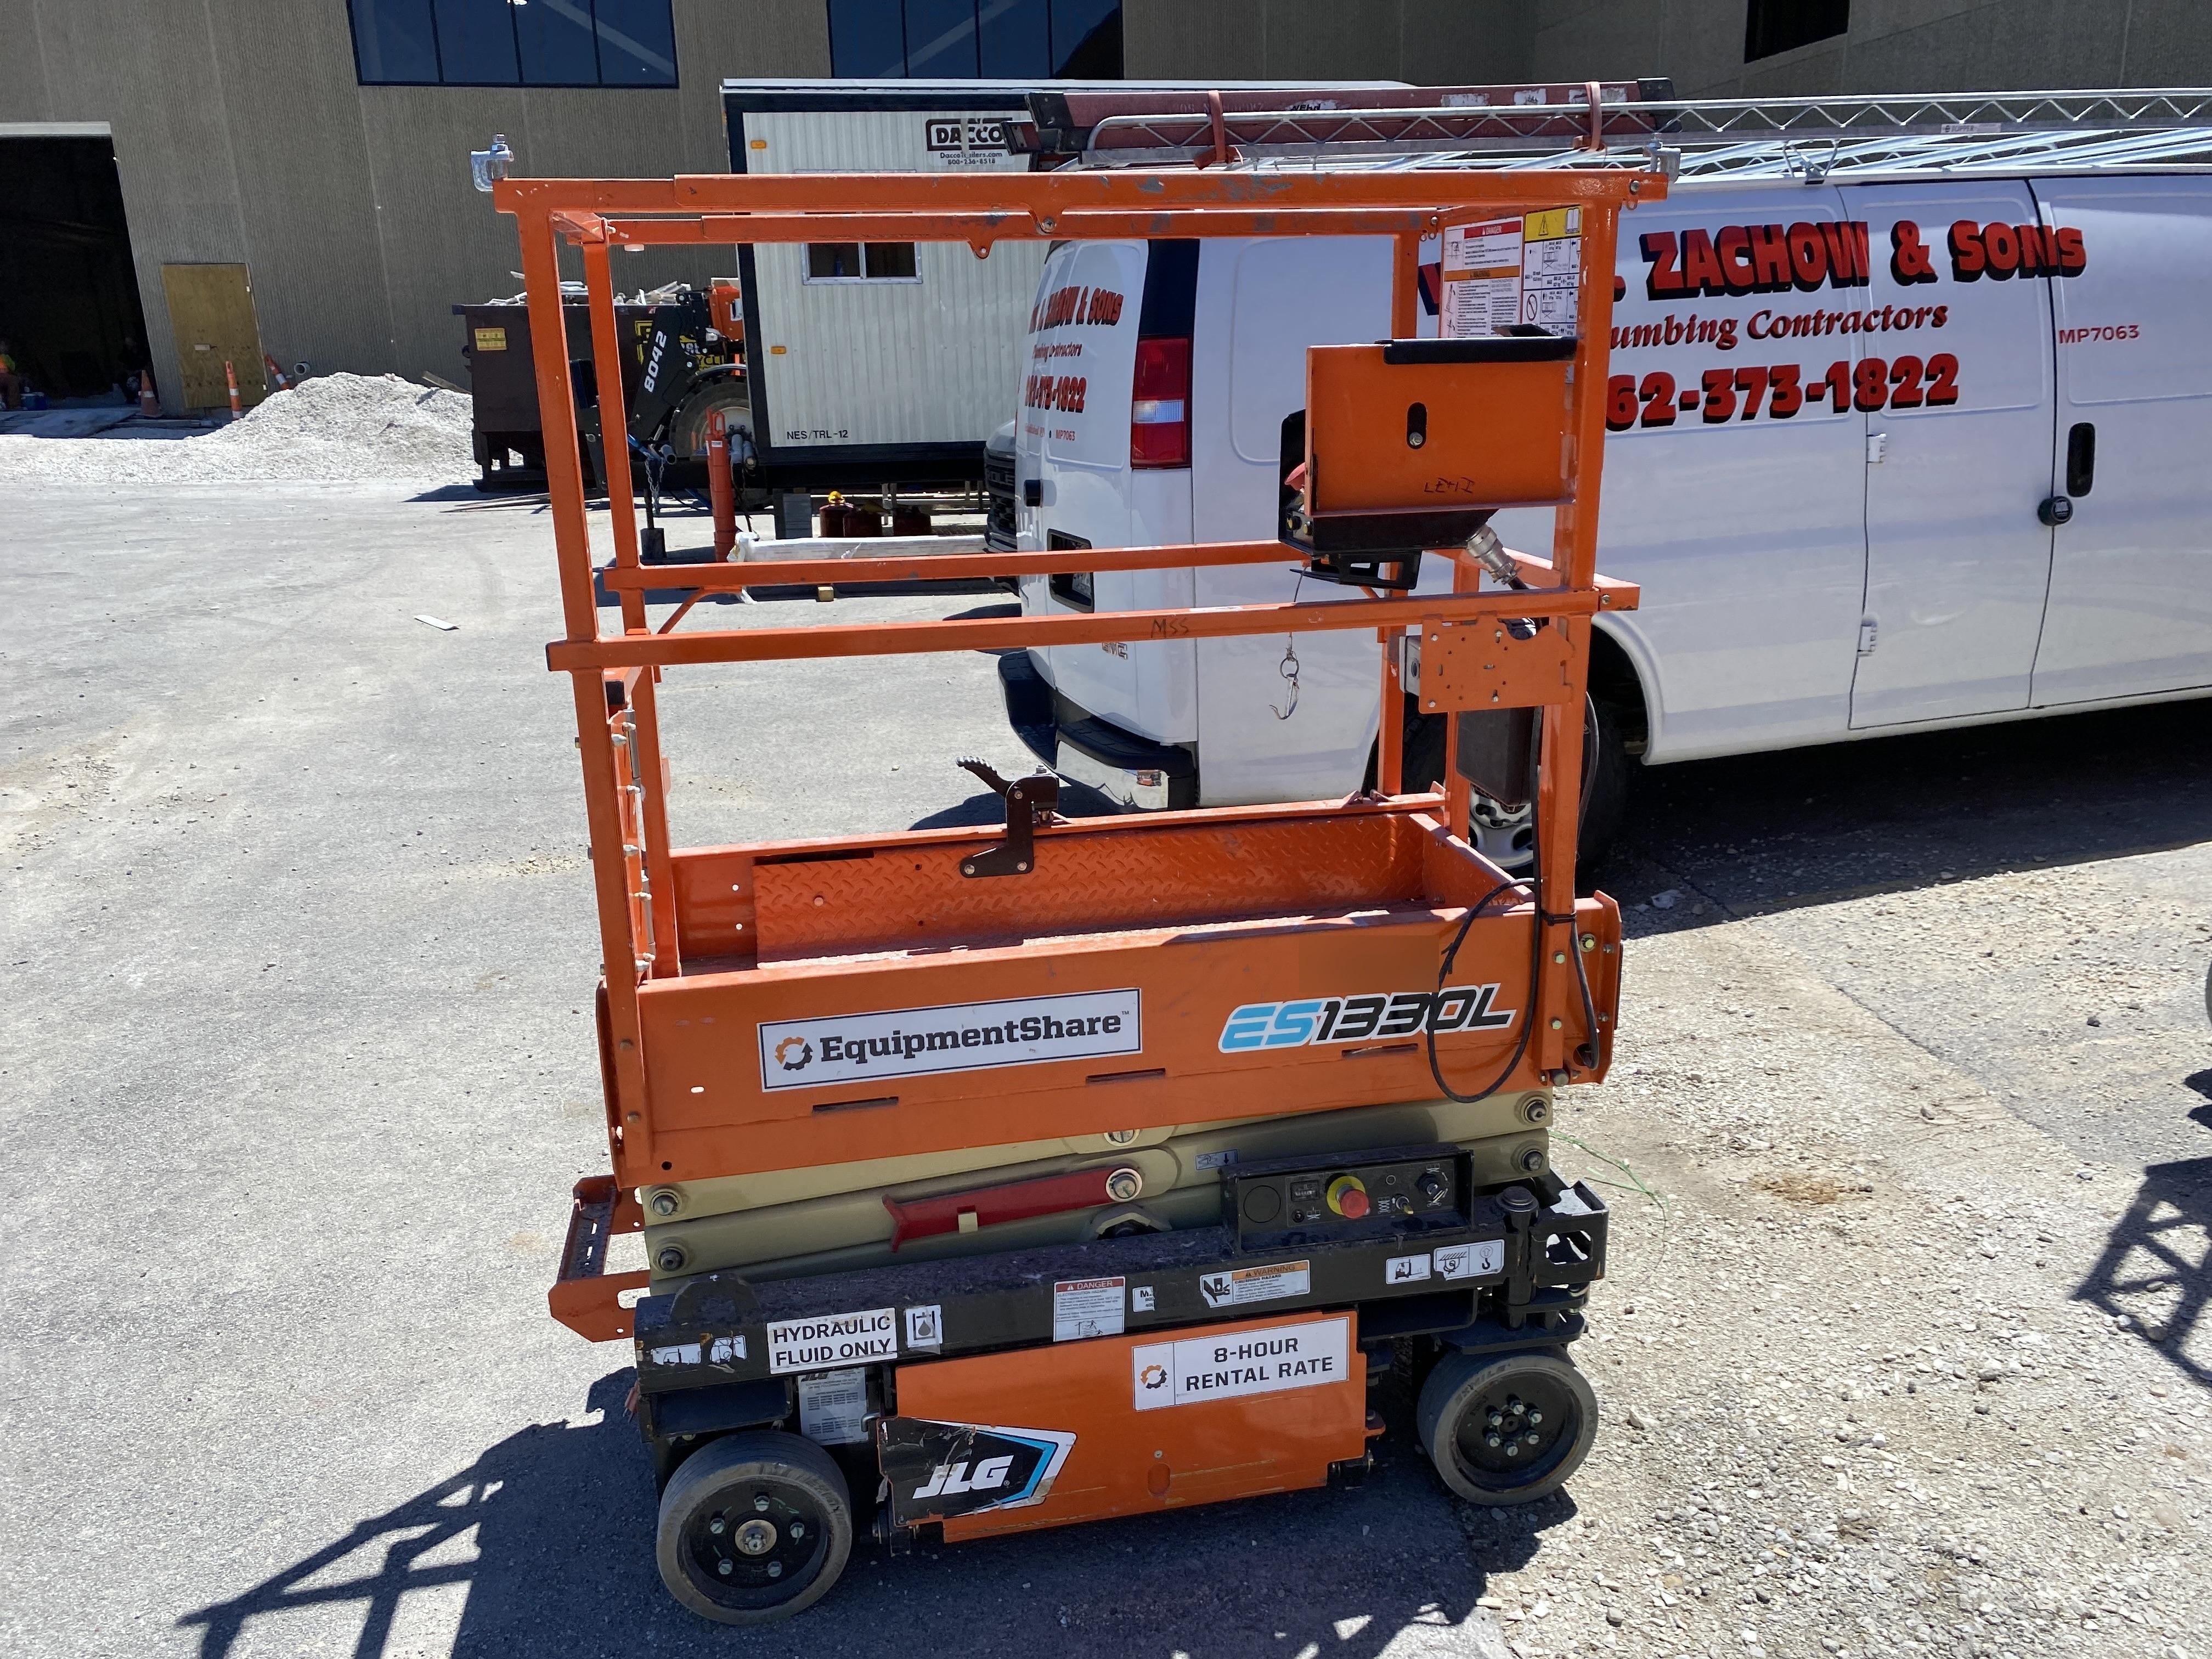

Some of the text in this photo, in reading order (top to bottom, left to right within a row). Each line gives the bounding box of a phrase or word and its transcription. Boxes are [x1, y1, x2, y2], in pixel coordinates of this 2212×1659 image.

[936, 126, 1004, 143] DACCO
[1640, 219, 2086, 301] ZACHOW & SONS
[1087, 287, 1124, 326] SONS
[1610, 303, 1949, 350] umbing Contractors
[2058, 324, 2139, 344] MP7063
[644, 330, 667, 393] 8042
[1606, 353, 1959, 431] 62-373-1822
[1101, 641, 1128, 661] GMC
[1220, 985, 1514, 1052] ES1330L
[821, 1015, 1121, 1065] EquipmentShare
[1077, 1280, 1113, 1290] DANGER
[1253, 1264, 1295, 1276] WARNING
[774, 1316, 891, 1344] HYDRAULIC
[776, 1338, 891, 1367] FLUID ONLY
[1214, 1337, 1299, 1363] 8-HOUR
[1186, 1356, 1333, 1391] RENTAL RATE
[912, 1455, 1014, 1499] JLG
